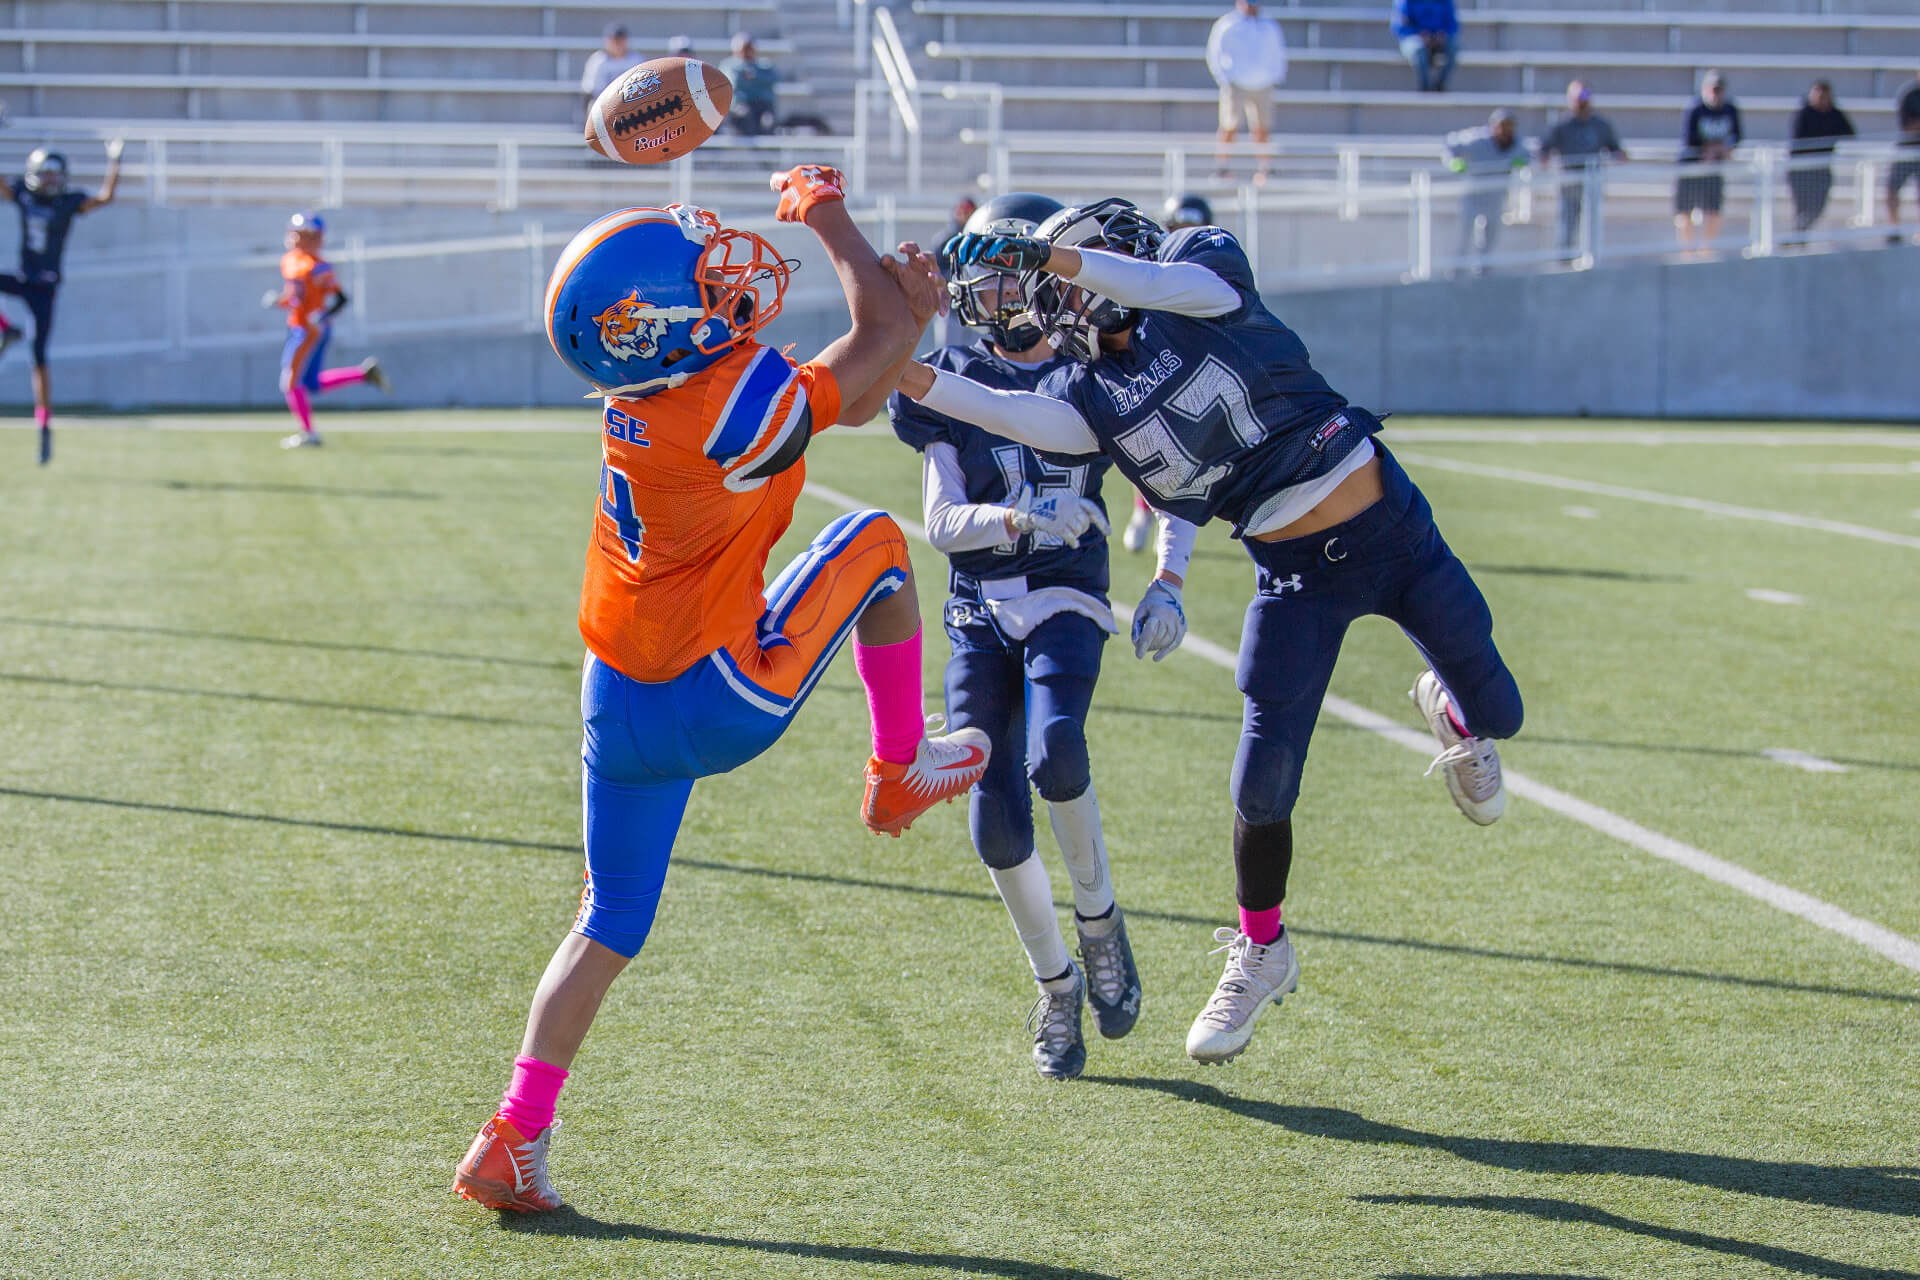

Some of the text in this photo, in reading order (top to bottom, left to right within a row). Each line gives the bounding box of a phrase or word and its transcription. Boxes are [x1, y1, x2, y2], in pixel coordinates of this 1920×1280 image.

[633, 124, 686, 152] Baden
[1111, 349, 1182, 416] BEARS
[605, 406, 651, 448] SE
